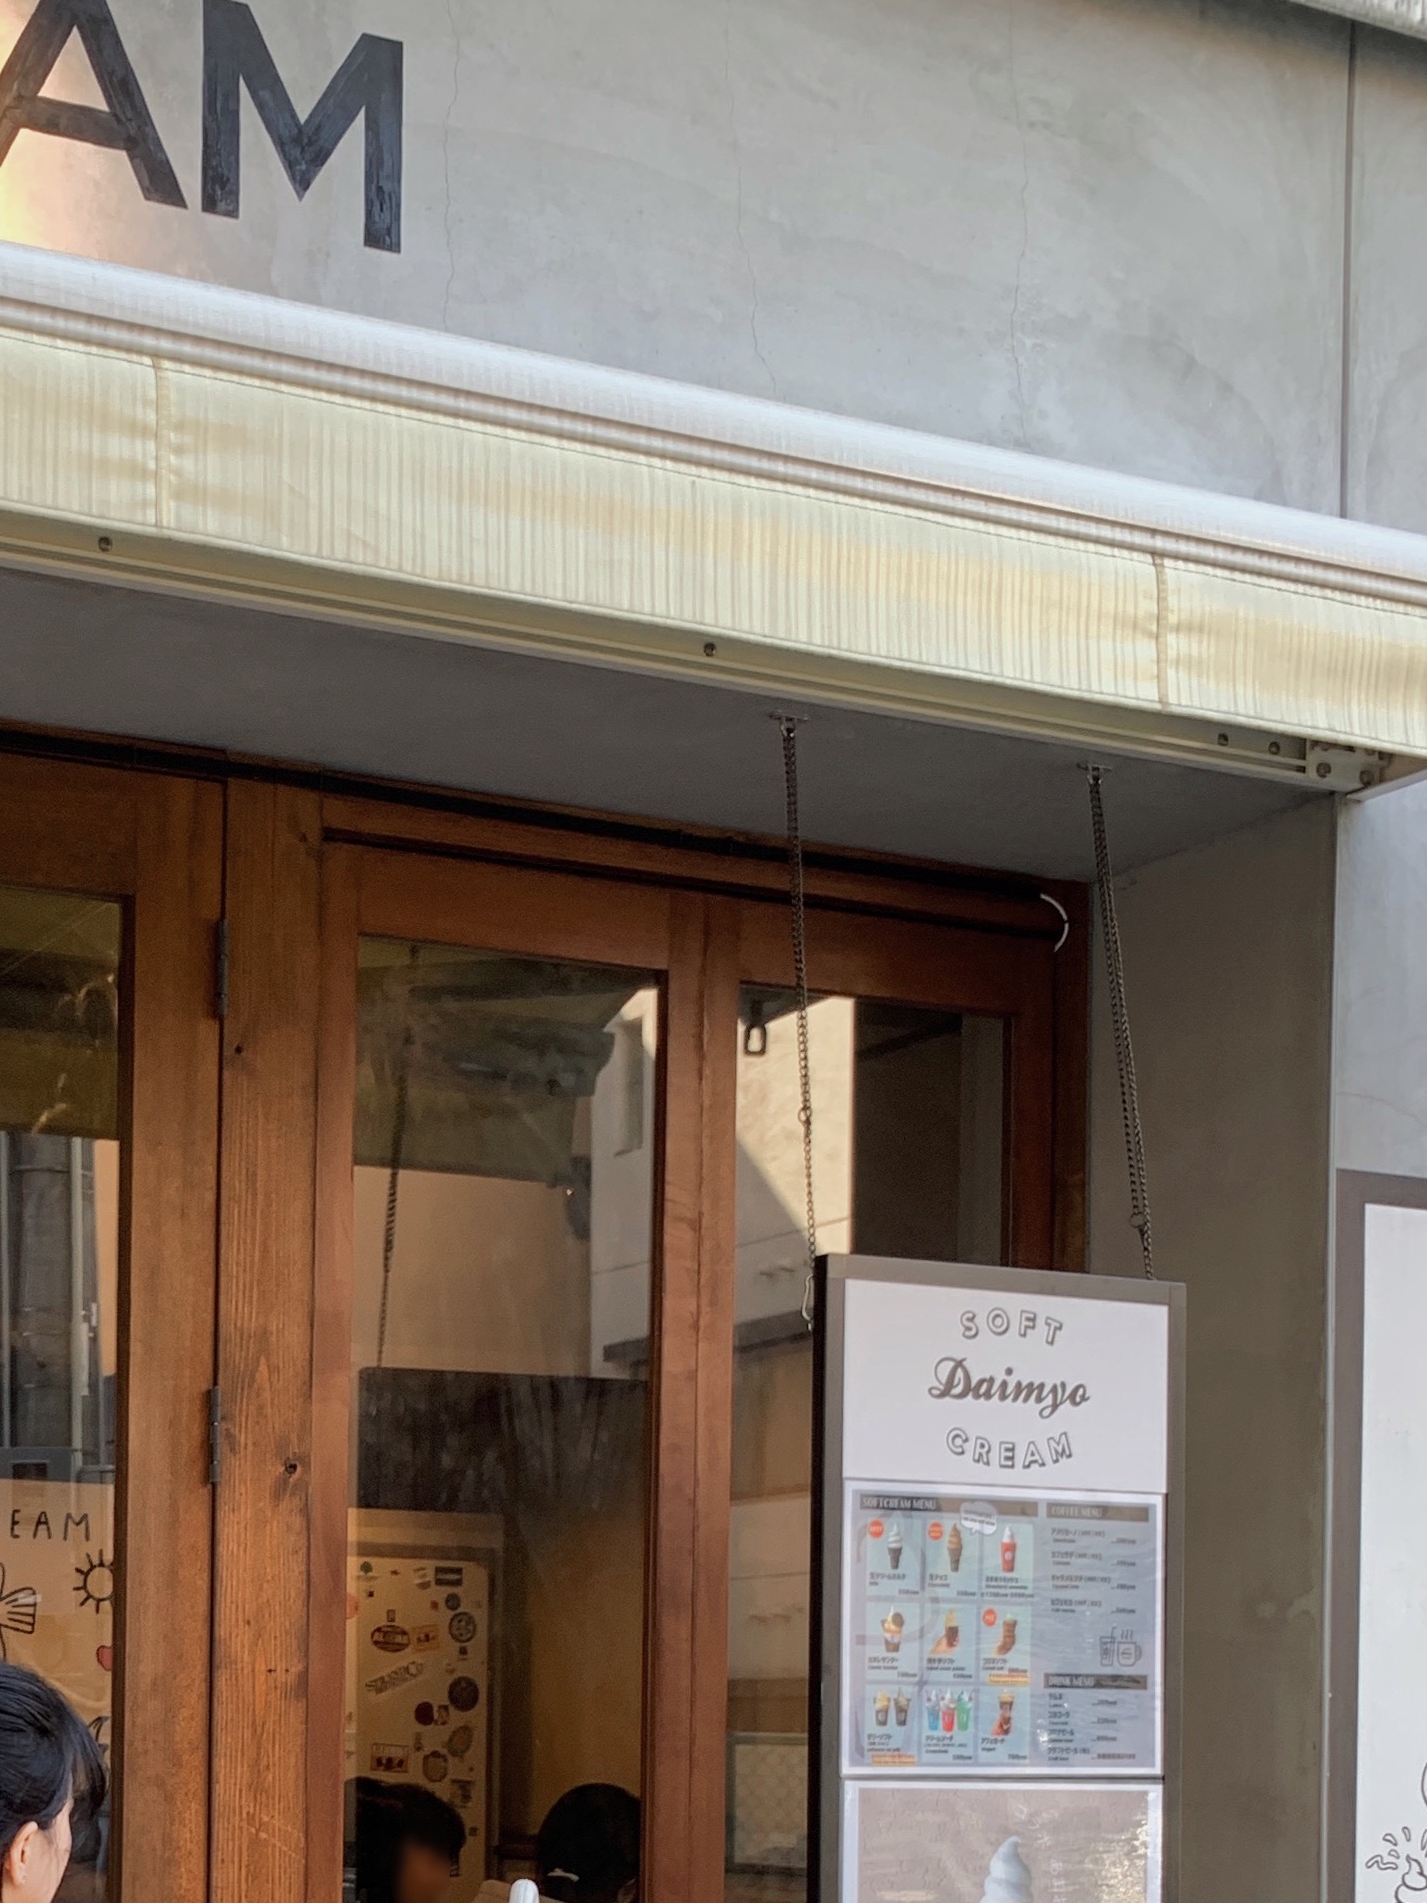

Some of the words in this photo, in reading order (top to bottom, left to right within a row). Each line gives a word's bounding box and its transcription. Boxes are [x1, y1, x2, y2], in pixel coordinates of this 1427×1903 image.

[959, 1307, 1064, 1346] SOFT
[927, 1355, 1091, 1420] Daimyo
[945, 1427, 1073, 1469] CREAM
[912, 1498, 937, 1510] MENU
